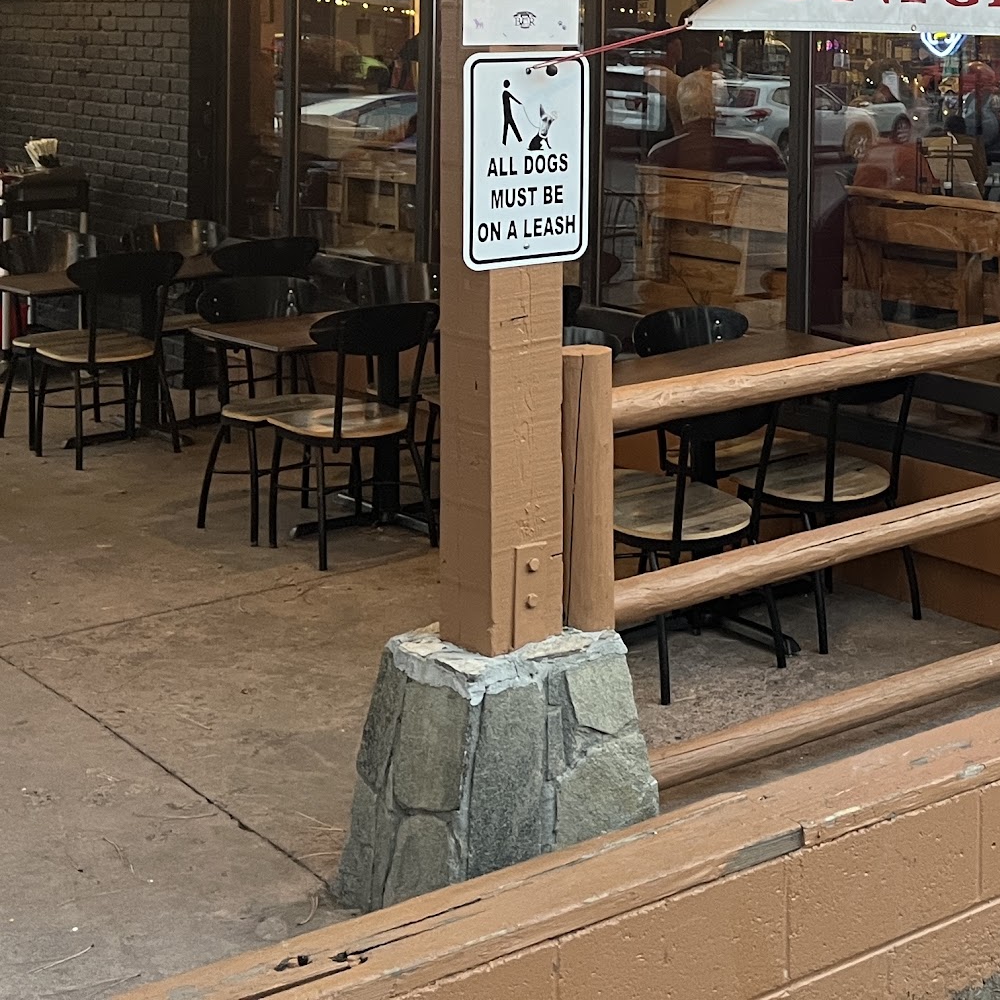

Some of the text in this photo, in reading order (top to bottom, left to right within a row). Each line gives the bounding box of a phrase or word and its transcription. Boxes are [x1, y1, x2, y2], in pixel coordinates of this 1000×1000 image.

[487, 153, 568, 177] ALL DOGS
[491, 185, 564, 209] MUST BE
[477, 214, 576, 242] ON A LEASH
